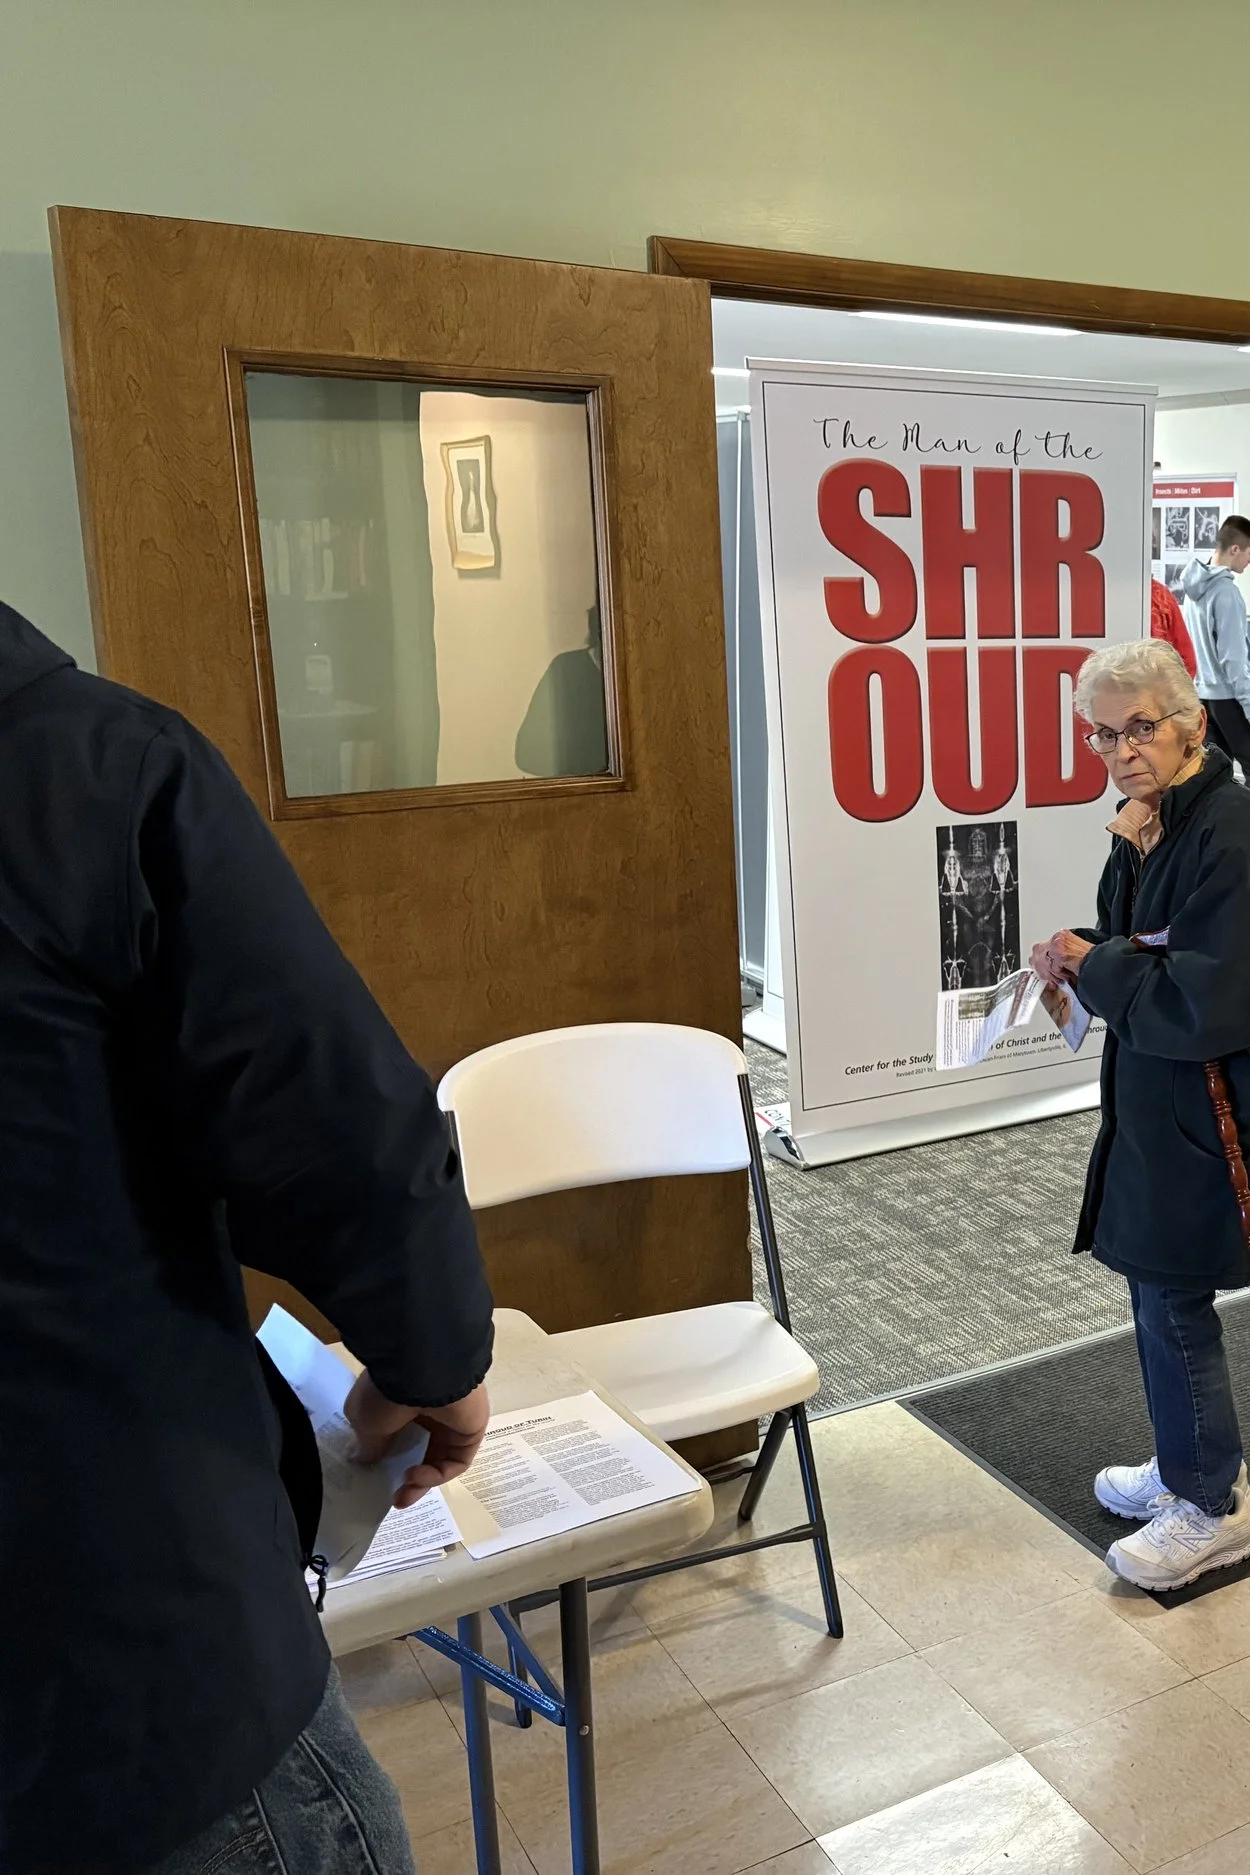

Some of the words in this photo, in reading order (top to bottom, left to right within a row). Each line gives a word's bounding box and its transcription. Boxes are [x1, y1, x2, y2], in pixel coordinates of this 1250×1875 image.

[813, 418, 888, 449] The
[902, 422, 981, 452] Man
[995, 429, 1031, 466] of
[1035, 431, 1103, 460] the
[817, 457, 1106, 644] SHR
[827, 645, 1108, 823] OUD
[844, 1063, 874, 1075] Center
[877, 1060, 890, 1071] for
[892, 1058, 907, 1068] the
[909, 1053, 934, 1065] Study
[995, 1040, 1005, 1050] of
[1006, 1037, 1030, 1048] Christ
[1031, 1033, 1048, 1044] and
[1049, 1031, 1062, 1041] the
